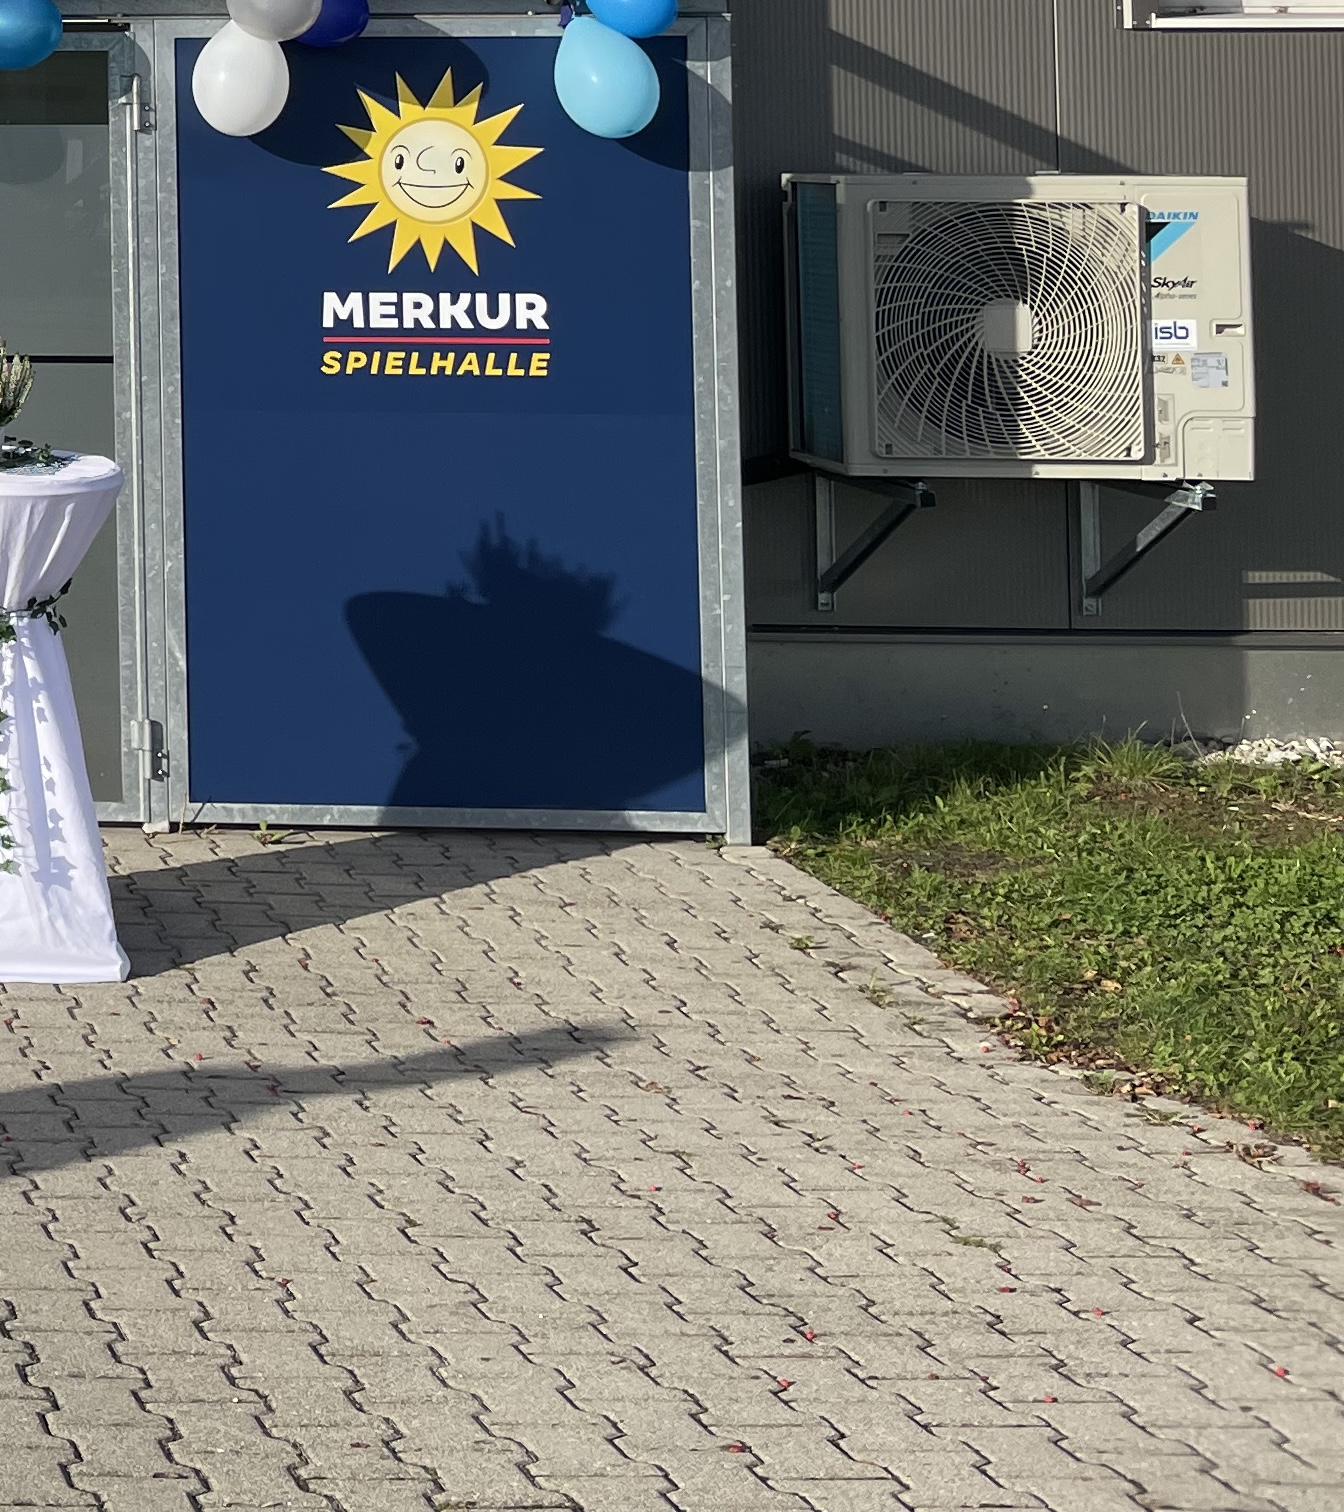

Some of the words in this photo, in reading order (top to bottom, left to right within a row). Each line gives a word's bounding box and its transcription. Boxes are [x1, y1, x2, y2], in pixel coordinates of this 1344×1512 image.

[1147, 211, 1200, 220] DAIKIN
[321, 291, 550, 330] MERKUR
[1154, 320, 1190, 340] isb
[320, 350, 551, 377] SPIELHALLE
